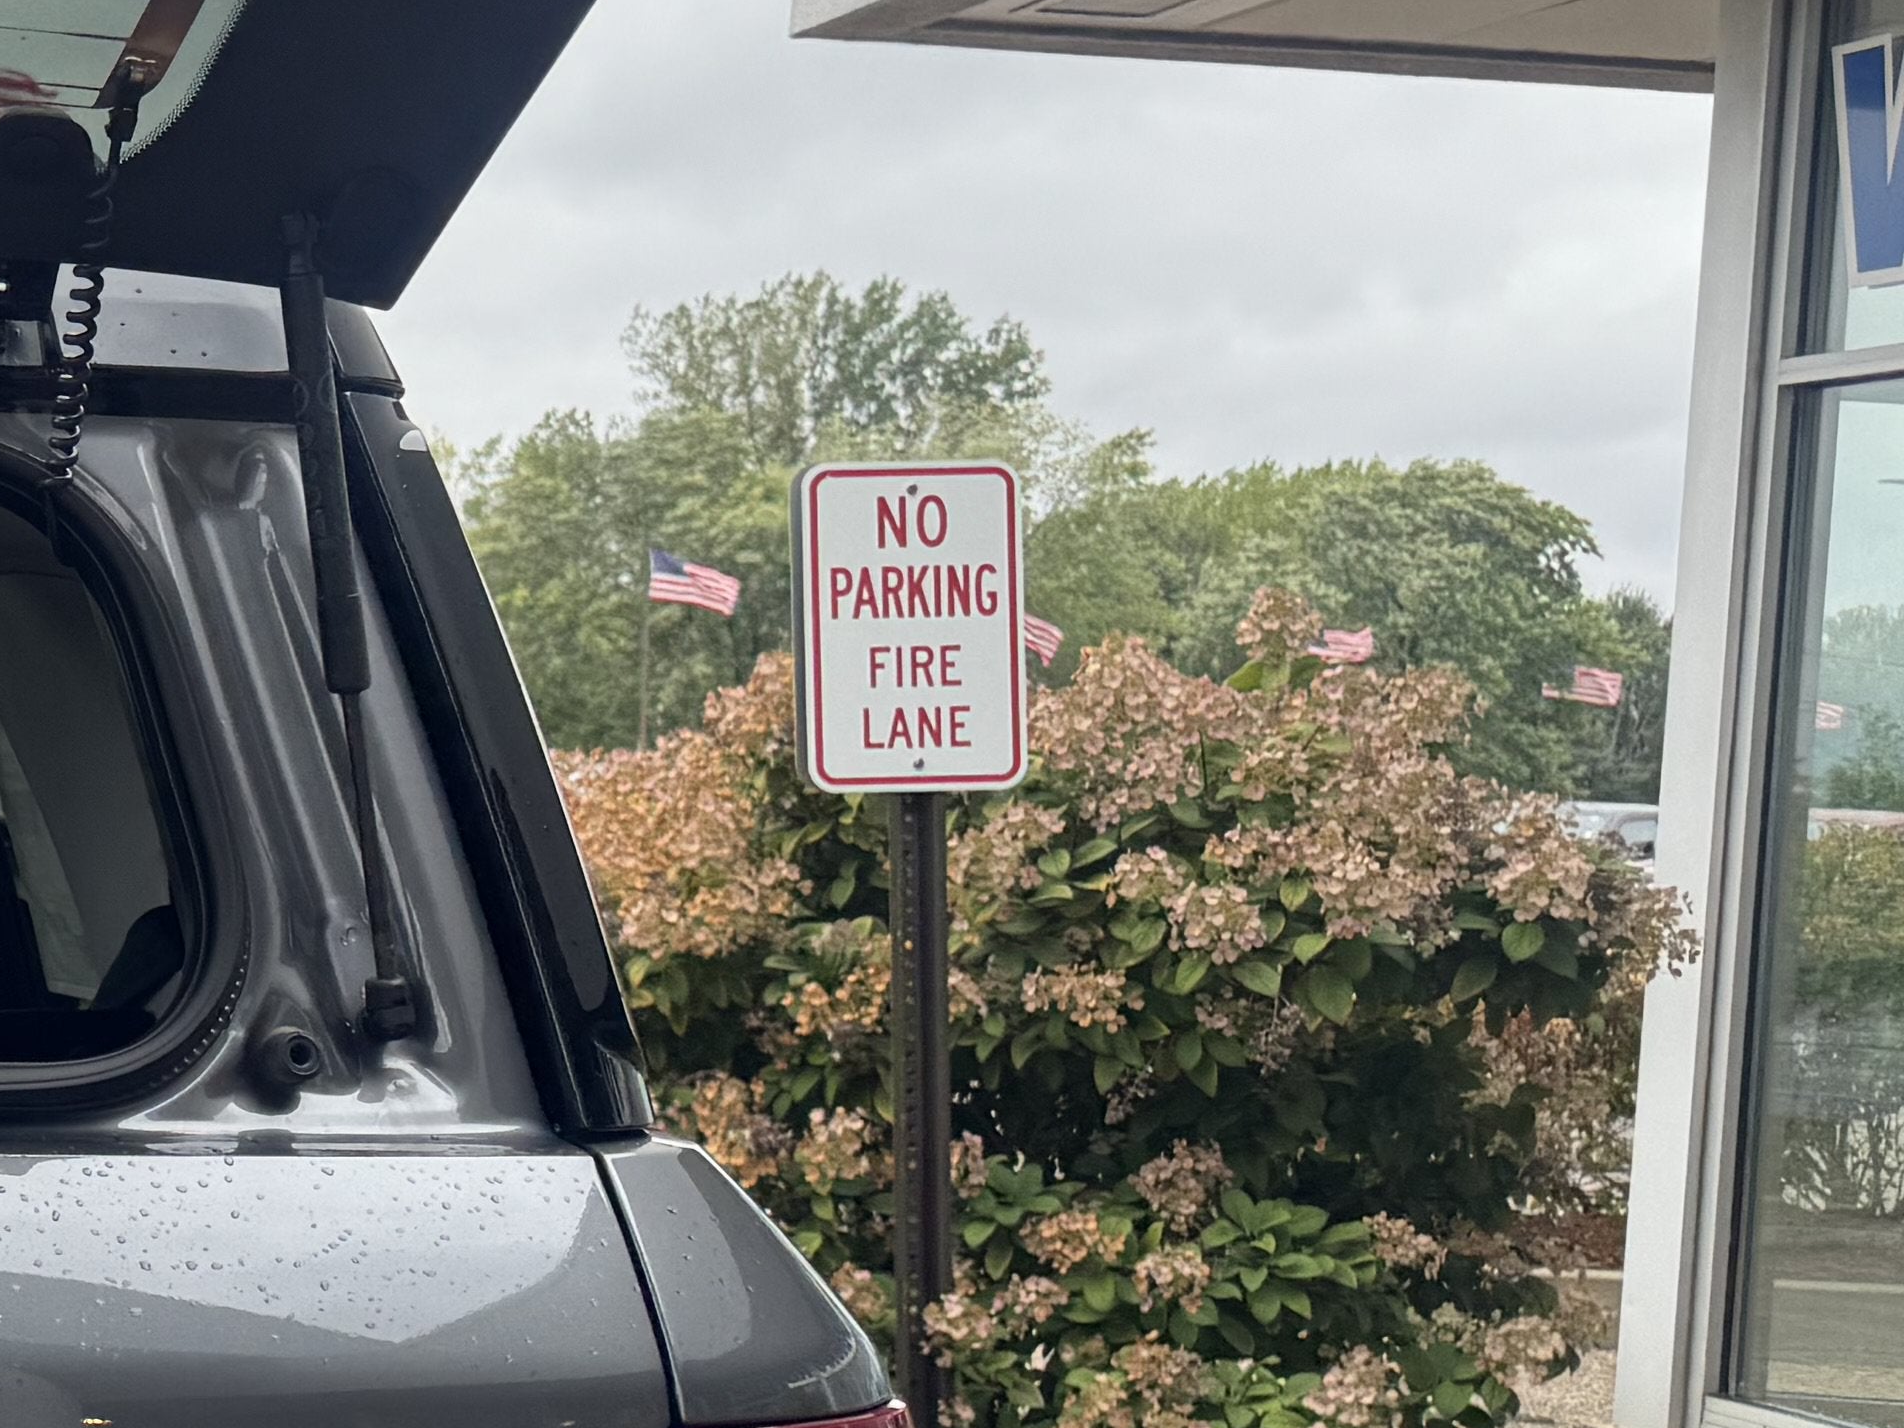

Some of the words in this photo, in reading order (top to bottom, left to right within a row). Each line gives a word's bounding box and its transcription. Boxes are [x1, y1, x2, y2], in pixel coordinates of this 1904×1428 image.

[877, 494, 948, 549] NO
[830, 563, 999, 619] PARKING
[869, 644, 962, 688] FIRE
[863, 705, 972, 749] LANE
